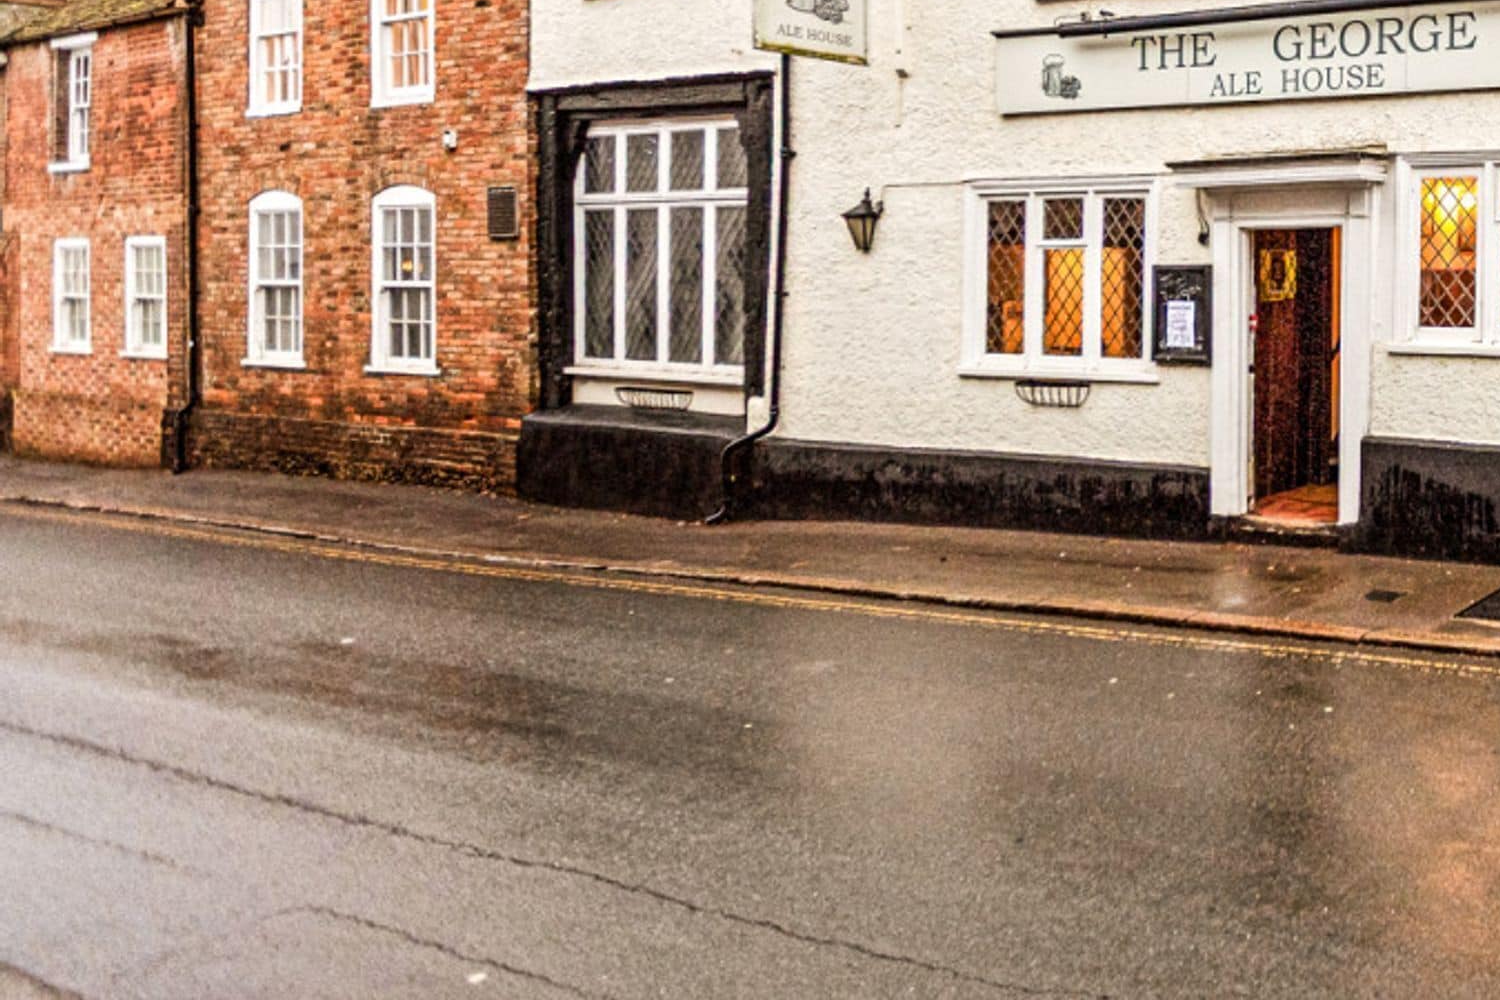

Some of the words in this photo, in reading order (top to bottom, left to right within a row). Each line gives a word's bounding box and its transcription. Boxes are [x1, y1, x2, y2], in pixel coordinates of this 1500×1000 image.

[776, 23, 803, 38] ALE
[806, 29, 853, 47] HOUSE
[1131, 32, 1217, 71] THE
[1273, 11, 1477, 62] GEORGE
[1210, 71, 1263, 97] ALE
[1281, 64, 1385, 94] HOUSE
